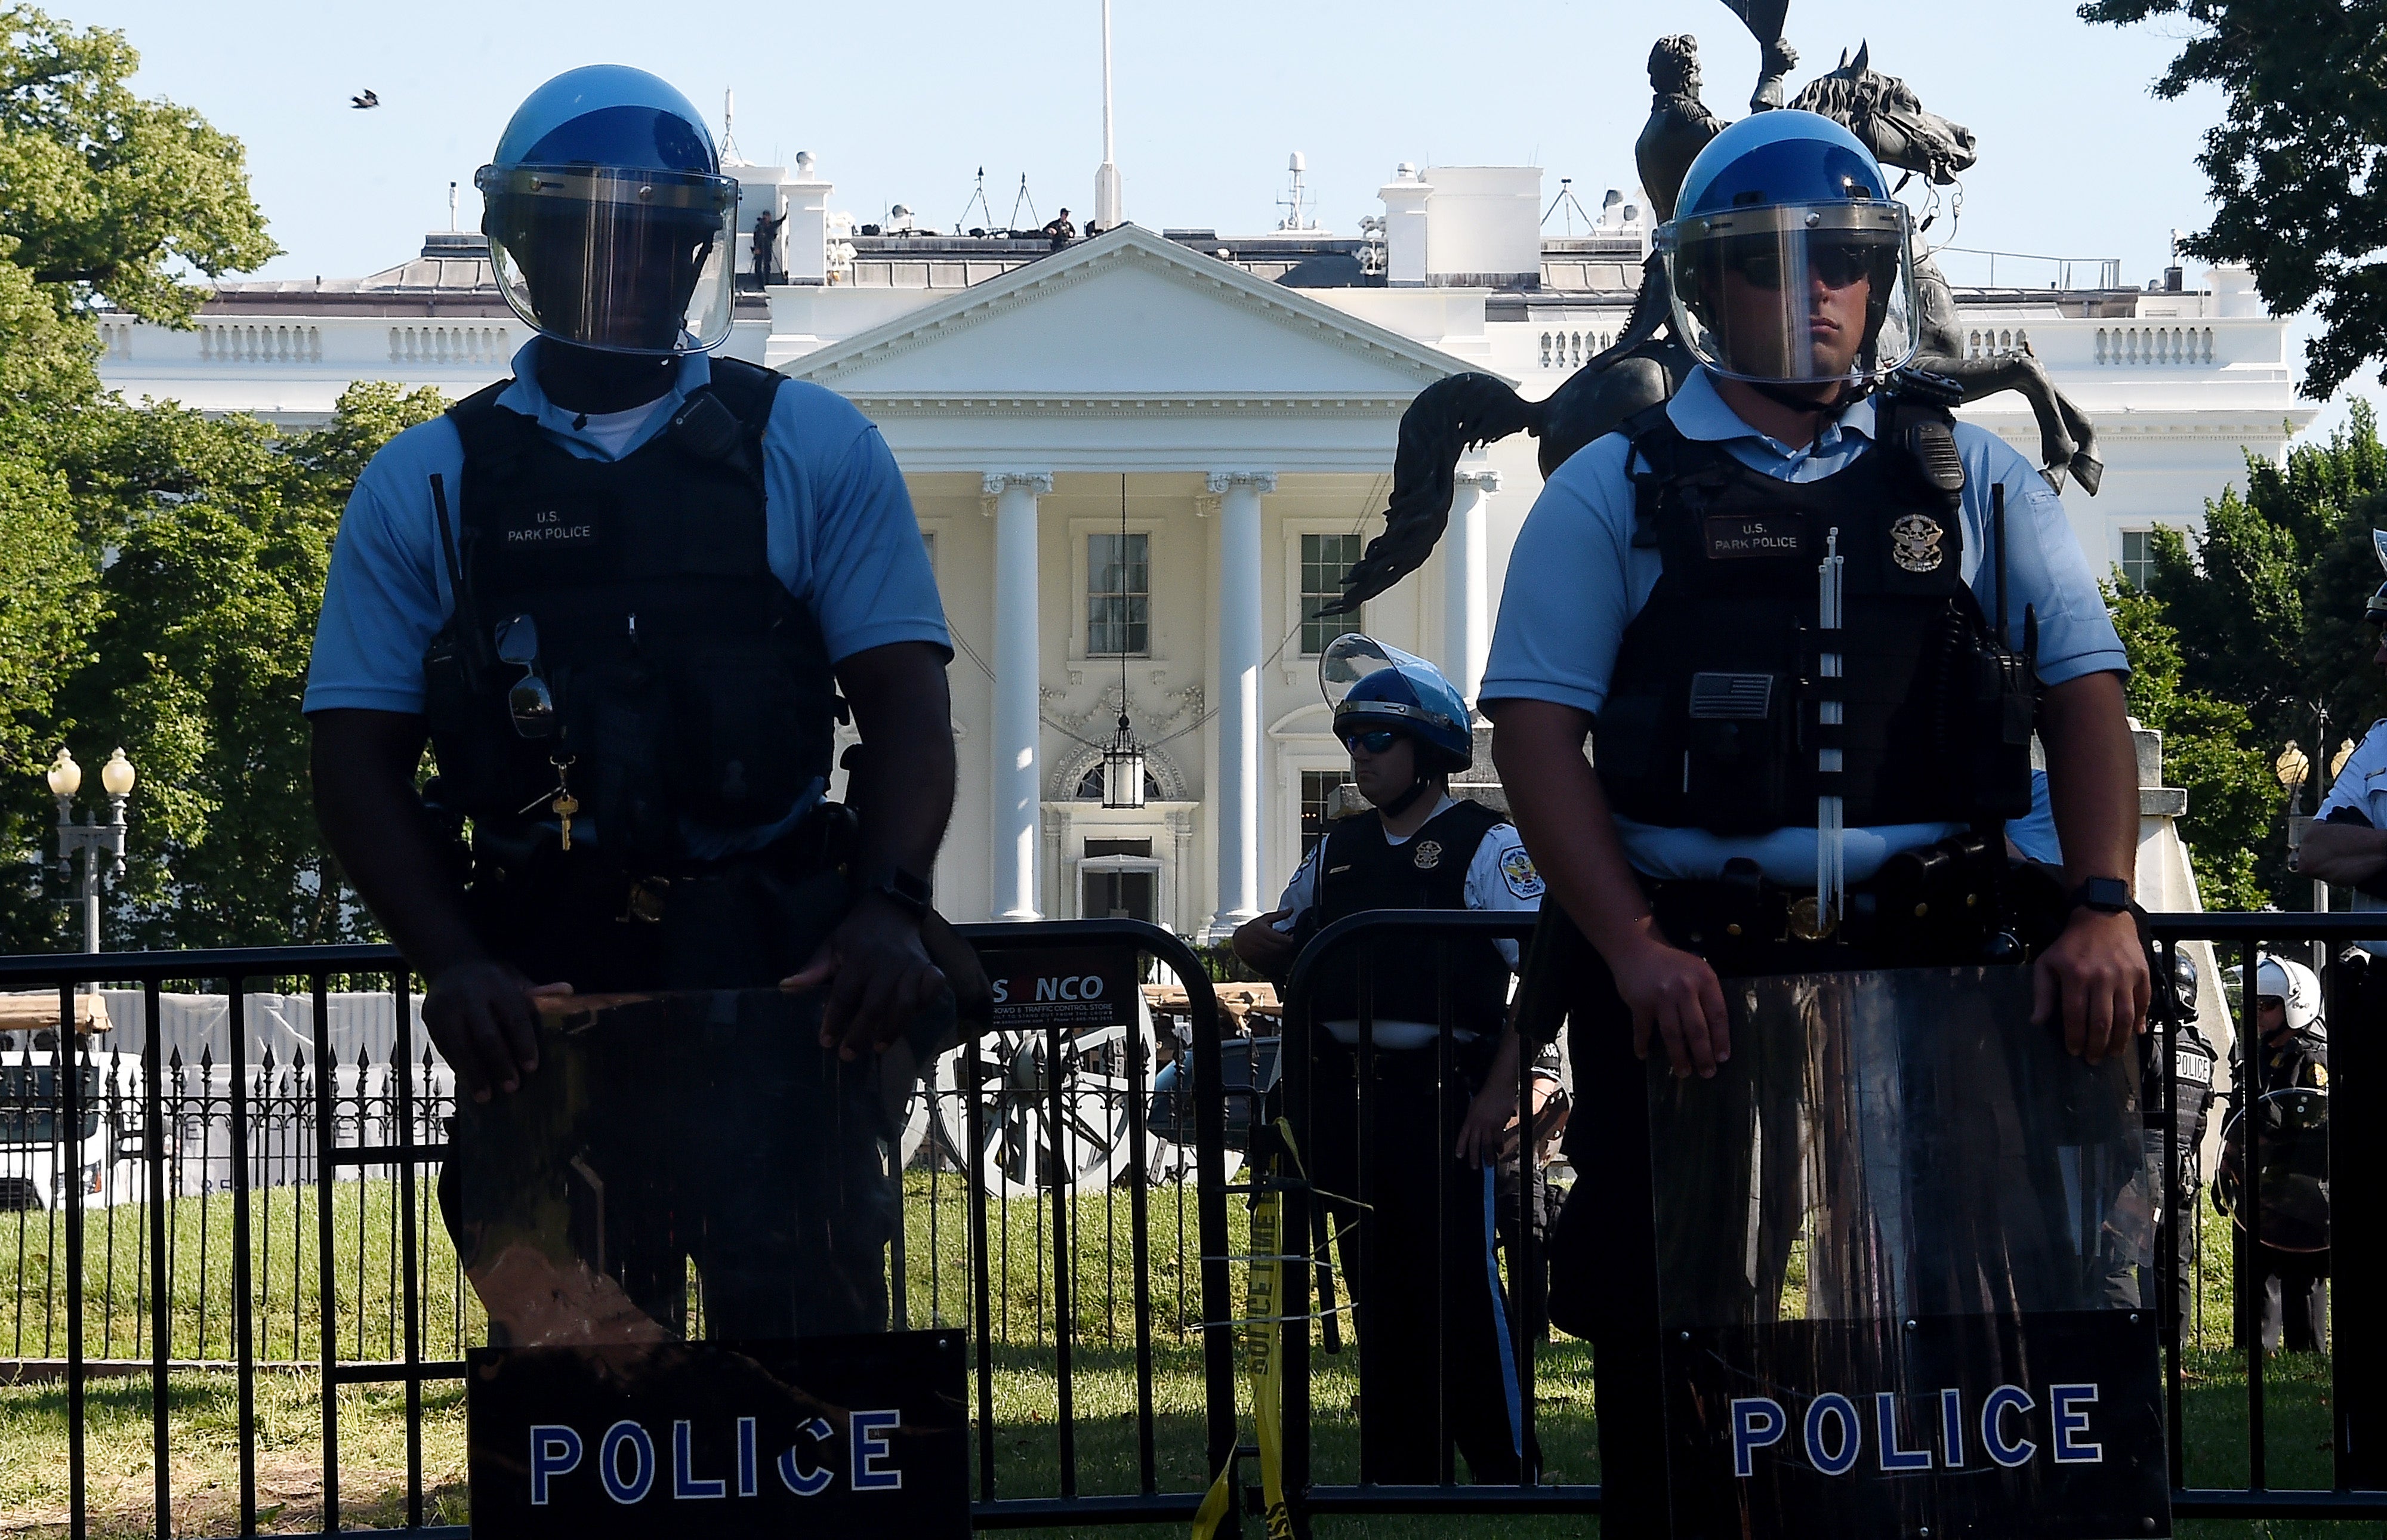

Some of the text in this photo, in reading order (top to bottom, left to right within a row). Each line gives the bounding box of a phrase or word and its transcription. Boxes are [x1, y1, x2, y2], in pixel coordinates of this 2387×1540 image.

[536, 511, 561, 523] U.S.
[507, 526, 591, 542] PARK POLICE
[1743, 523, 1768, 535] U.S.
[1714, 537, 1797, 550] PARK POLICE
[1731, 1383, 2103, 1477] POLICE
[529, 1409, 902, 1505] POLICE
